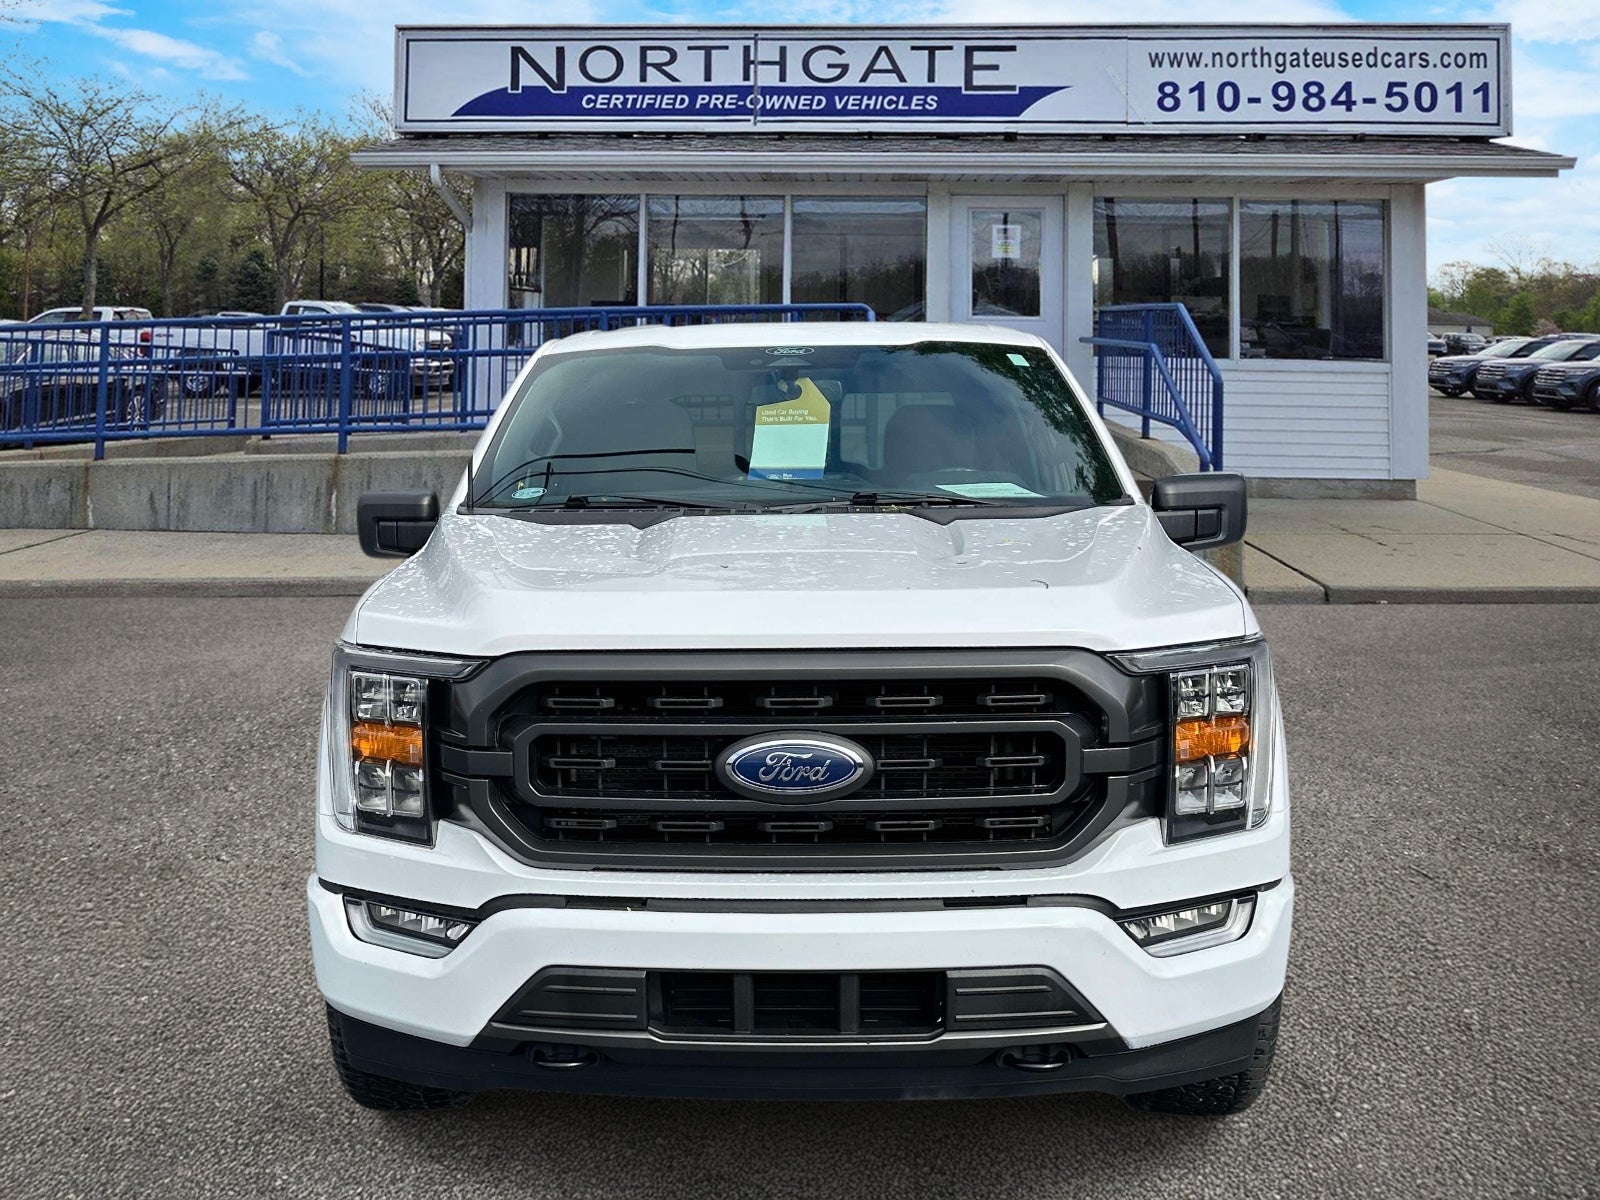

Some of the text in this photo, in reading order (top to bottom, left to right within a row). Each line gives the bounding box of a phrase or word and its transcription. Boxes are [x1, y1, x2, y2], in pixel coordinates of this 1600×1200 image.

[510, 45, 1017, 92] NORTHGATE
[1148, 46, 1488, 73] www.northgateusedcars.com
[581, 93, 939, 111] CERTIFIED PRE-OWNED VEHICLES
[1156, 80, 1491, 113] 810-984-5011
[759, 752, 830, 781] Ford
